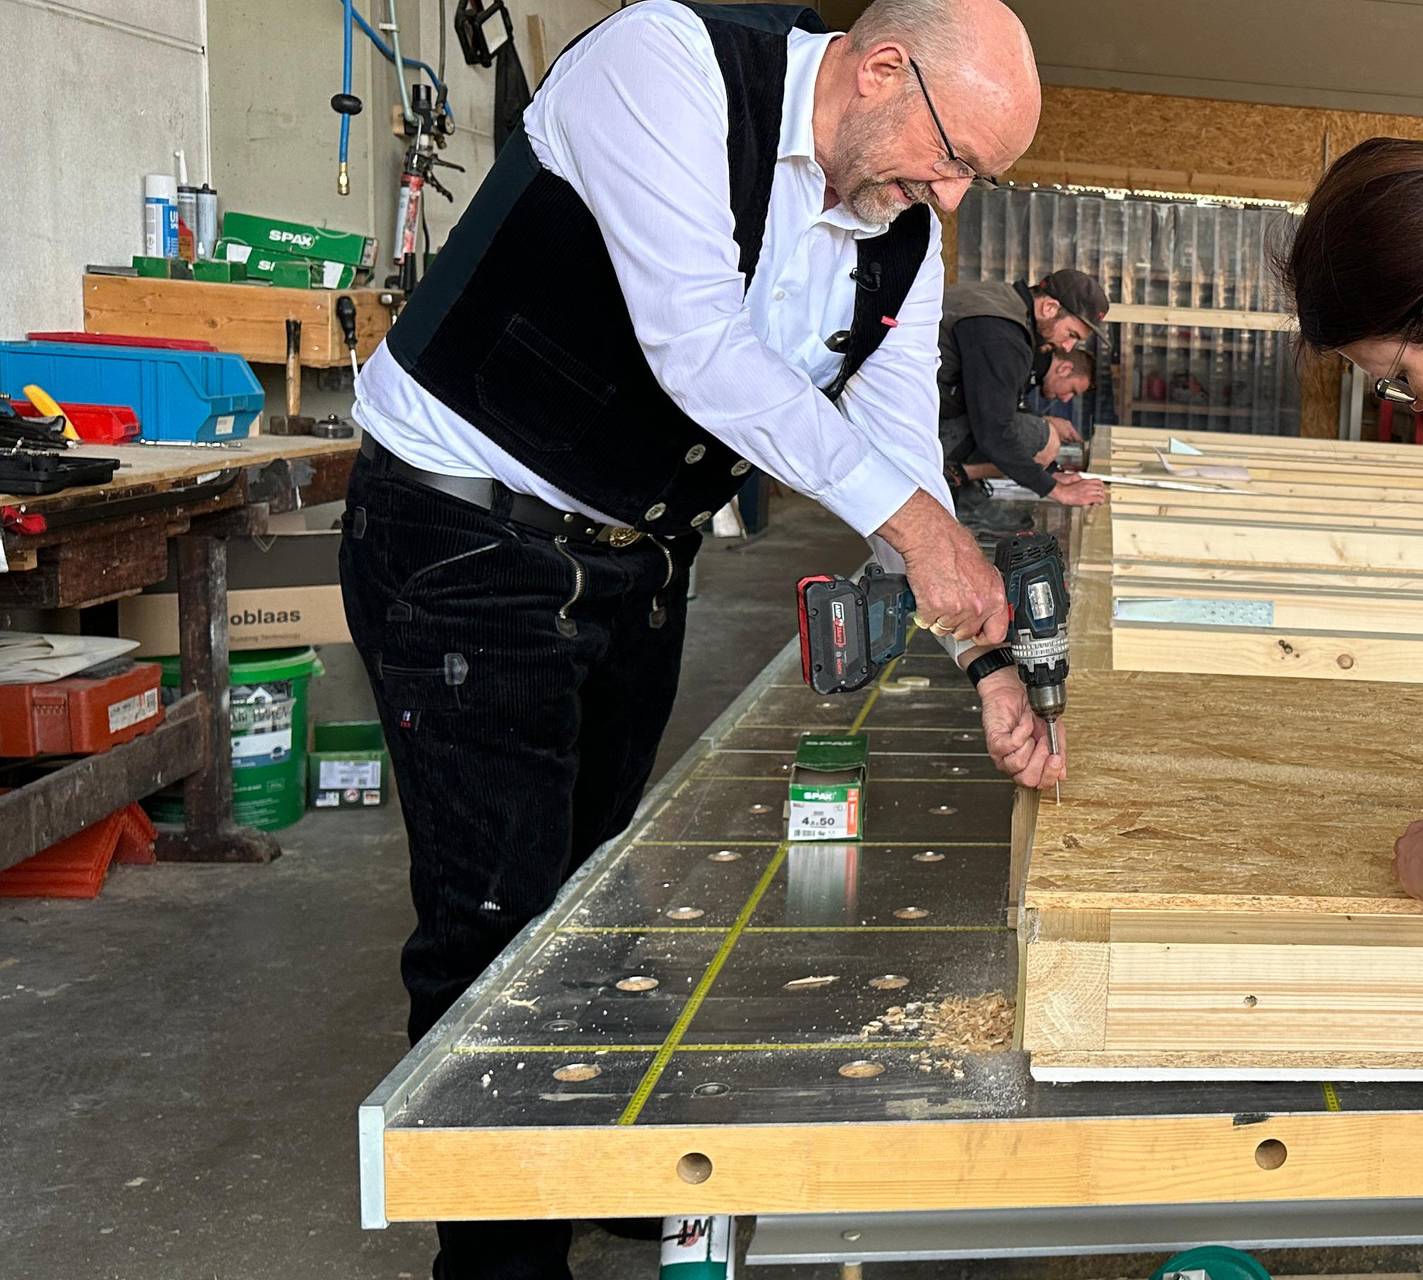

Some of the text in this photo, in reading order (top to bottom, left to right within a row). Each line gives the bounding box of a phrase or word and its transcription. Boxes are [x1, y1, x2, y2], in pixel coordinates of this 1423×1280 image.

[268, 229, 314, 248] SPAX
[230, 609, 301, 626] oblaas
[803, 791, 833, 801] SPAX
